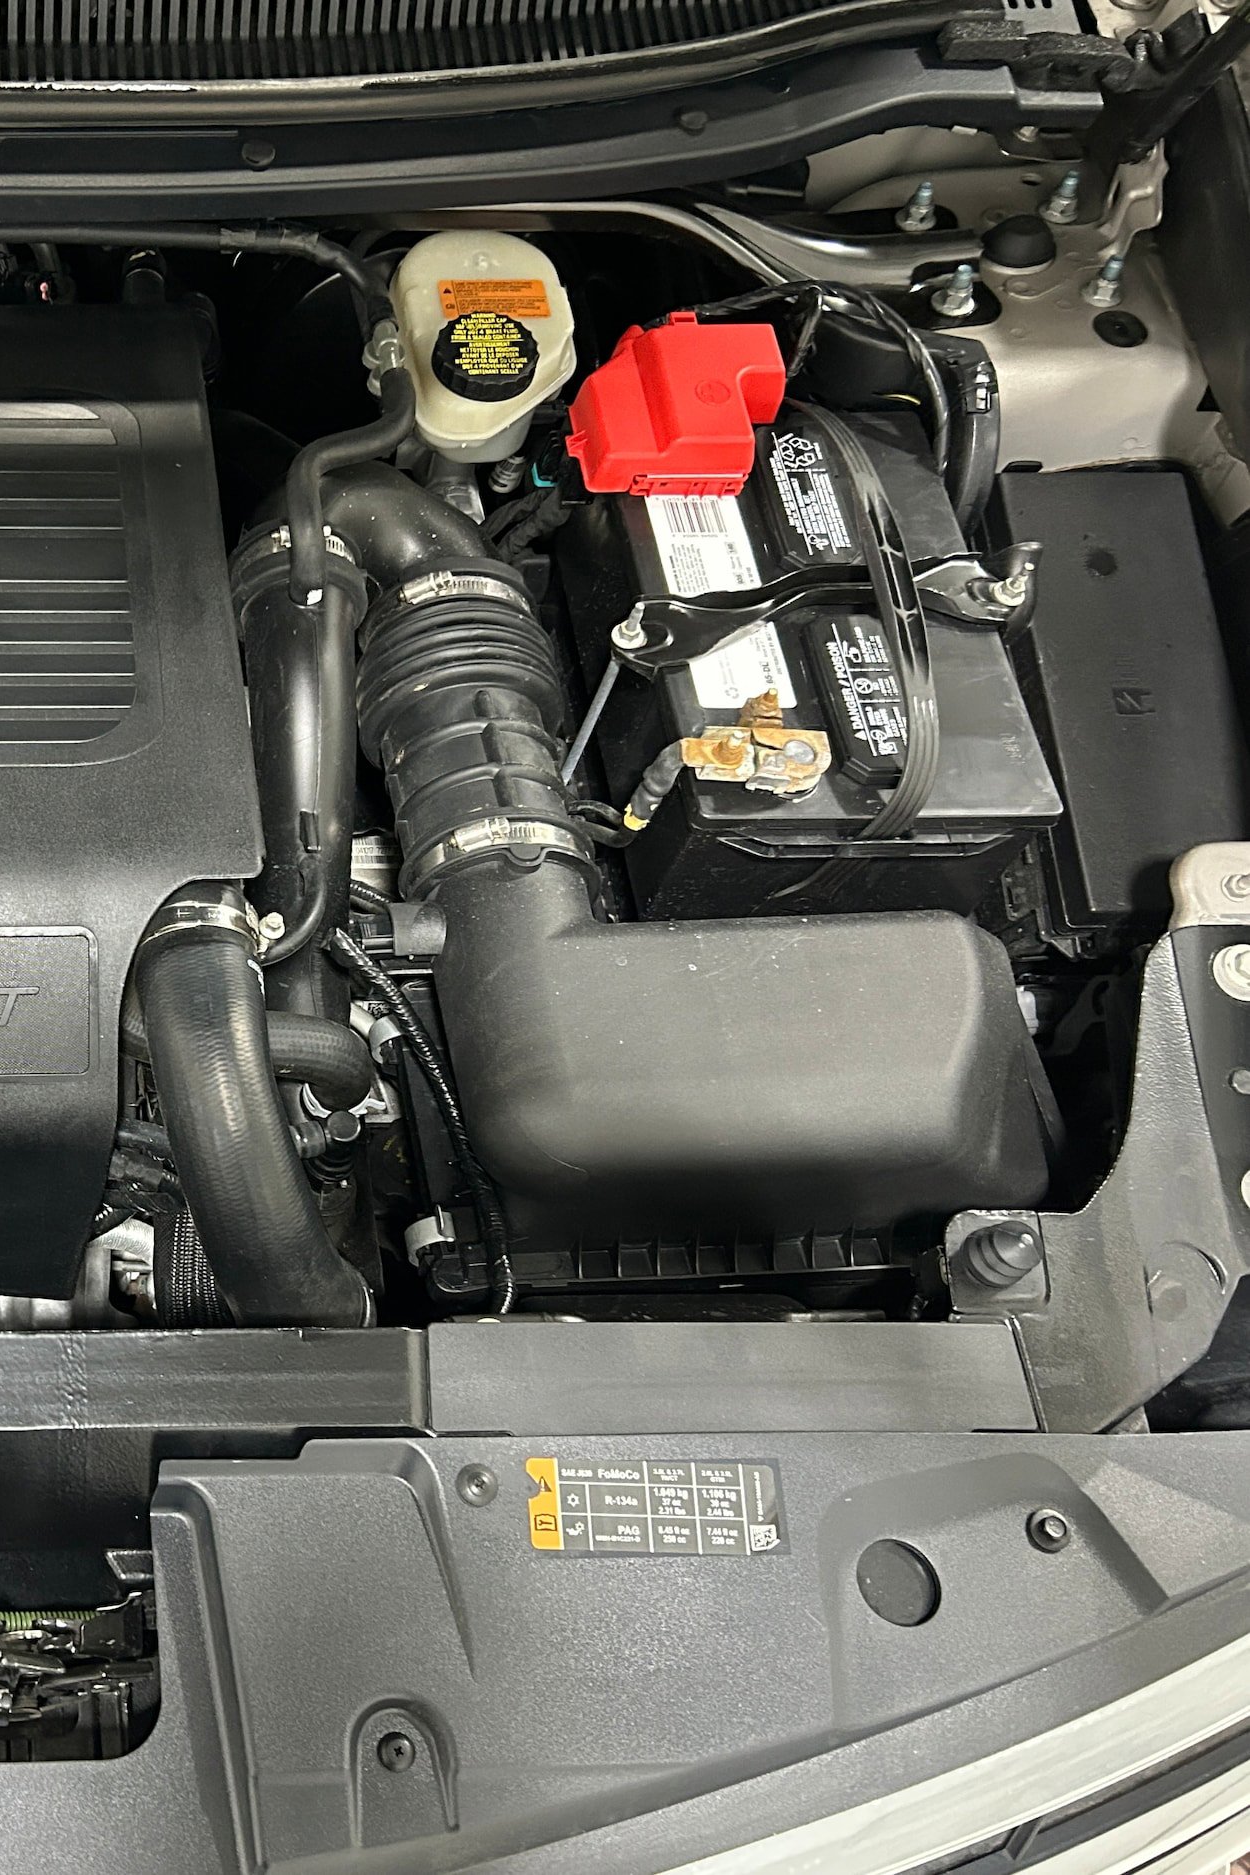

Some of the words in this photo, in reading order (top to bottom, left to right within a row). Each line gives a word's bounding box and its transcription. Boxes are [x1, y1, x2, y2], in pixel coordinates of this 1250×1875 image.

[826, 642, 848, 679] POISON
[841, 687, 864, 730] DANGER
[561, 1468, 576, 1477] SAE
[598, 1469, 640, 1480] FoMoCo
[677, 1488, 688, 1500] kg
[725, 1490, 736, 1501] kg
[605, 1495, 638, 1506] R-134a
[662, 1498, 670, 1506] 37
[672, 1499, 681, 1507] oz
[617, 1525, 640, 1535] PAG
